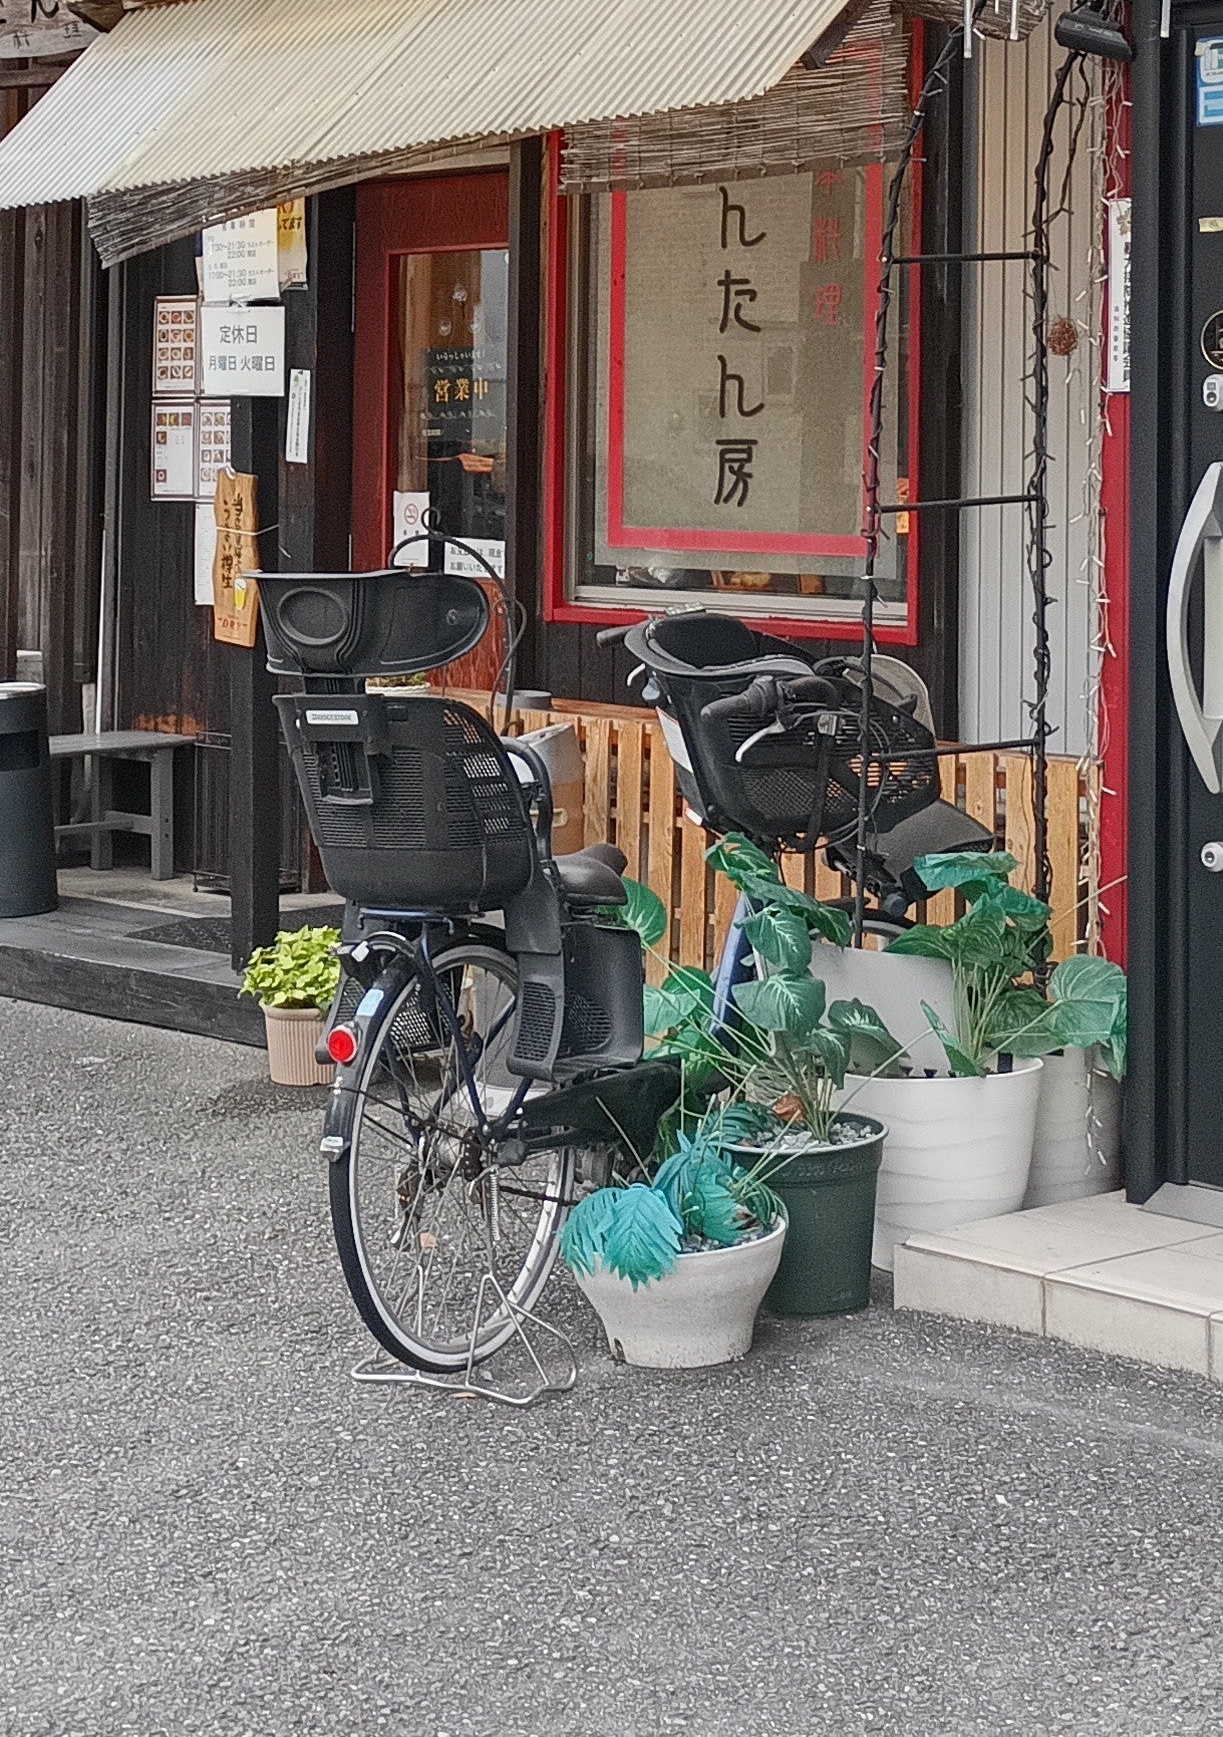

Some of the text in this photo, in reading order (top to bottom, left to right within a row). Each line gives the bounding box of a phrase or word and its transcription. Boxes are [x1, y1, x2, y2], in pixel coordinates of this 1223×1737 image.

[219, 325, 258, 344] 定休日
[209, 355, 275, 371] 月曜日 火曜日
[434, 376, 489, 403] 営業中
